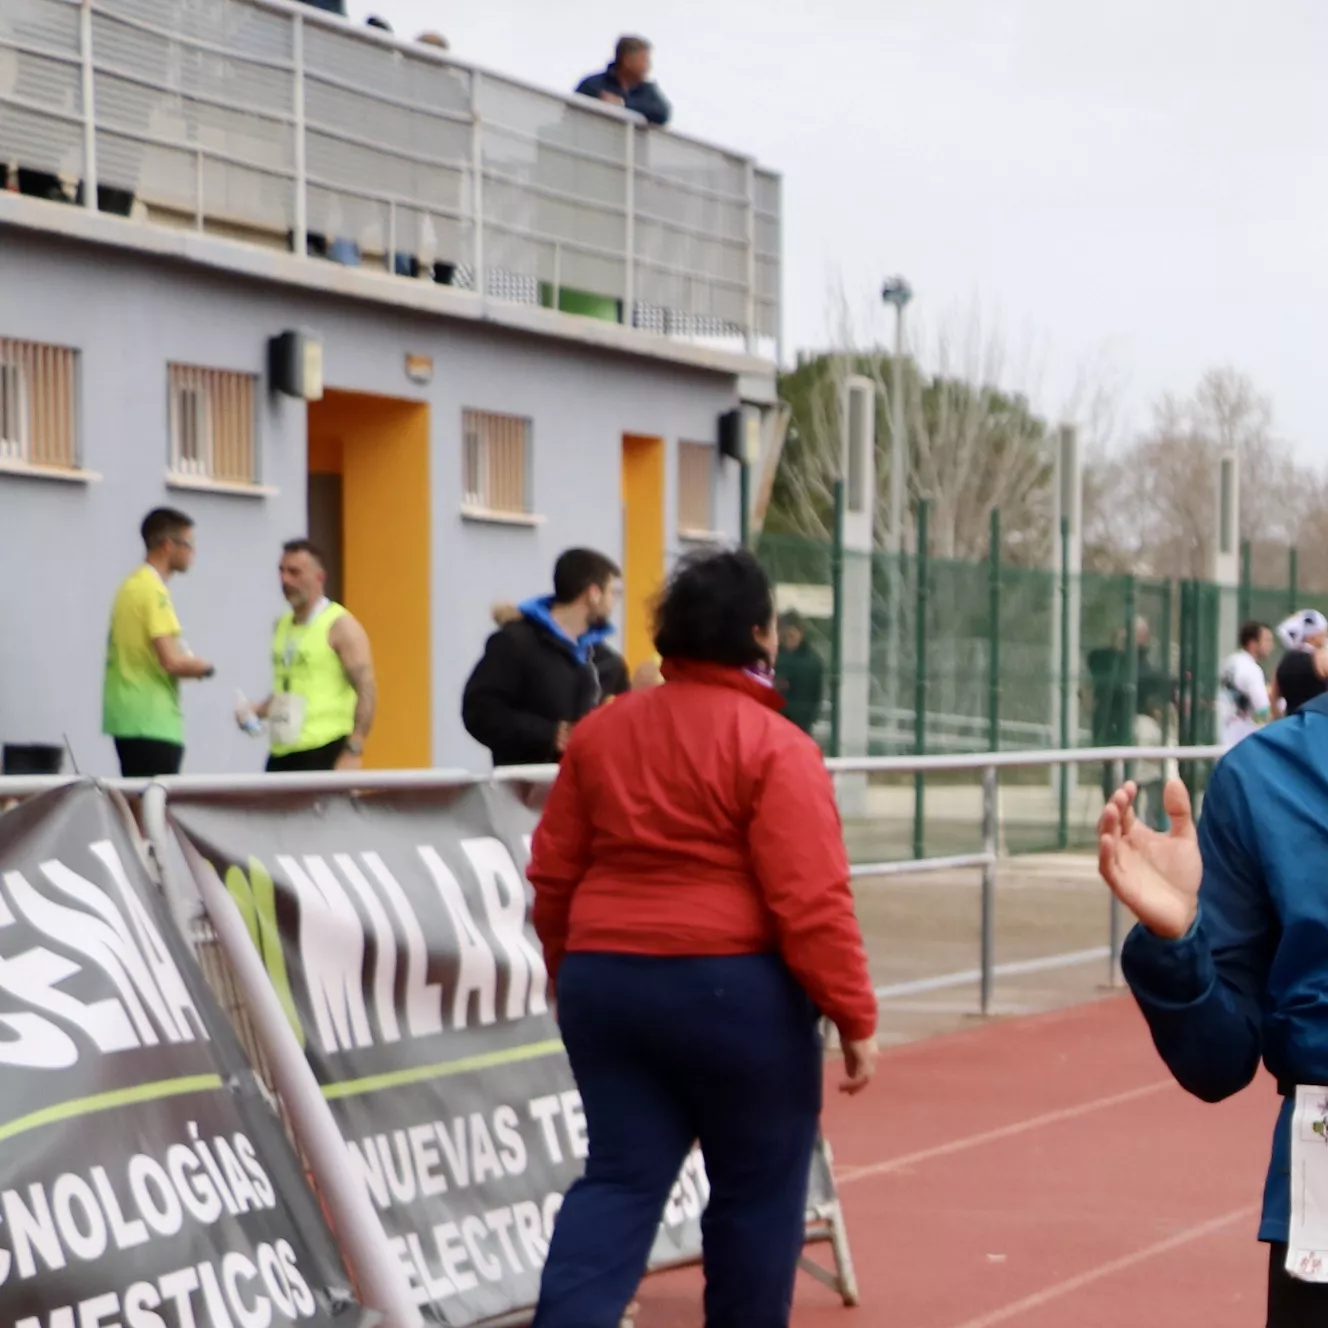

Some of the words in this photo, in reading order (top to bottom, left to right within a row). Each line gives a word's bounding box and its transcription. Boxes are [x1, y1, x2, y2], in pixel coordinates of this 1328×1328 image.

[275, 836, 548, 1054] MILAR
[0, 1121, 276, 1287] NOLOGÍAS
[347, 1105, 527, 1208] NUEVAS
